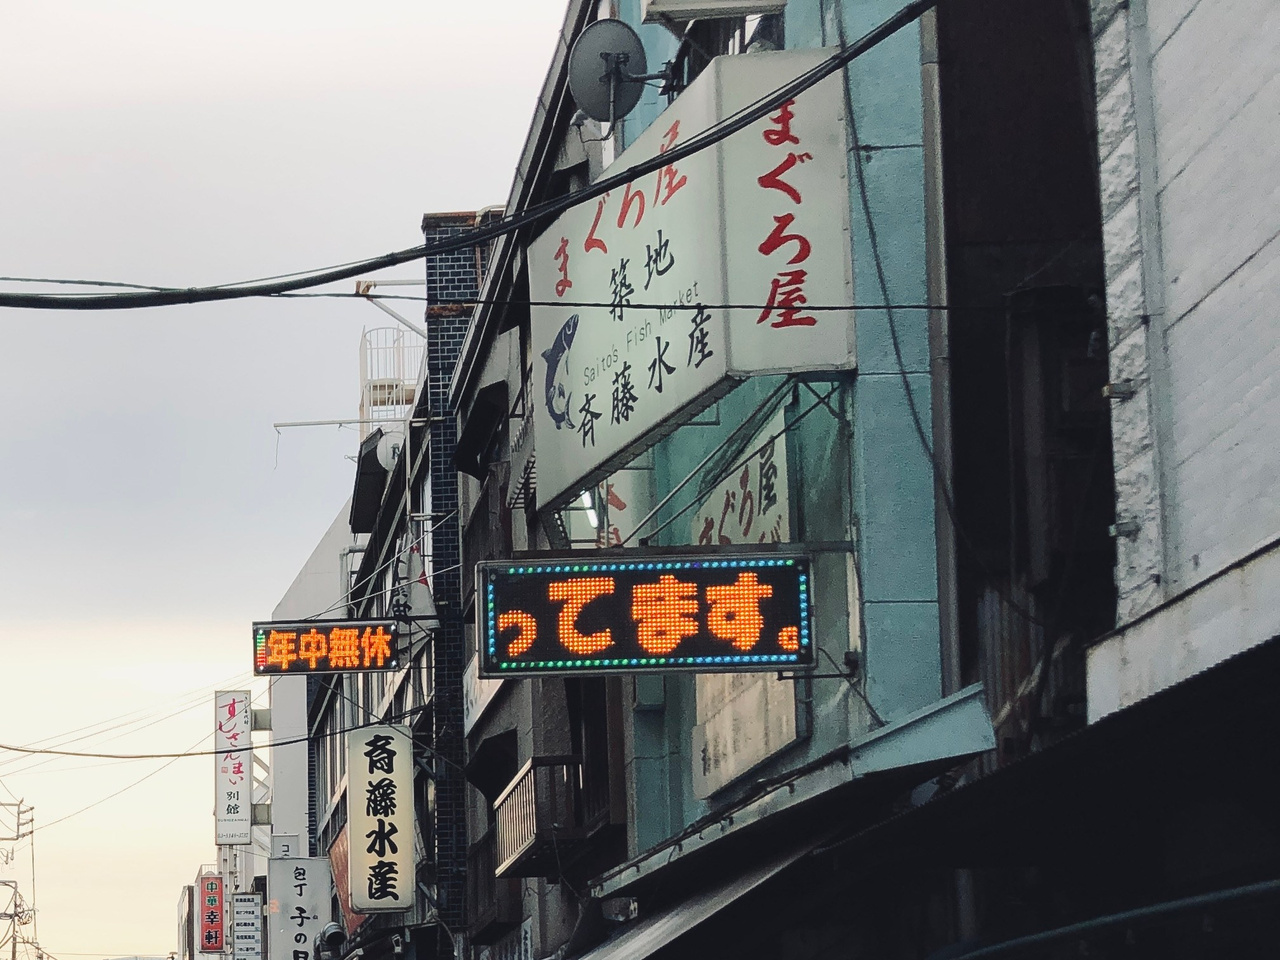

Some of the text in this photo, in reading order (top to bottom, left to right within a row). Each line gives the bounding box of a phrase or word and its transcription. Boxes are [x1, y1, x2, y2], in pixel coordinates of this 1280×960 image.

[756, 100, 818, 329] まぐろ屋
[609, 229, 675, 321] 築地
[627, 320, 652, 353] Fish
[659, 280, 699, 325] Market
[267, 627, 391, 670] 年中無休
[498, 572, 799, 657] ってます。
[226, 791, 240, 815] 別館
[294, 867, 307, 897] 包丁
